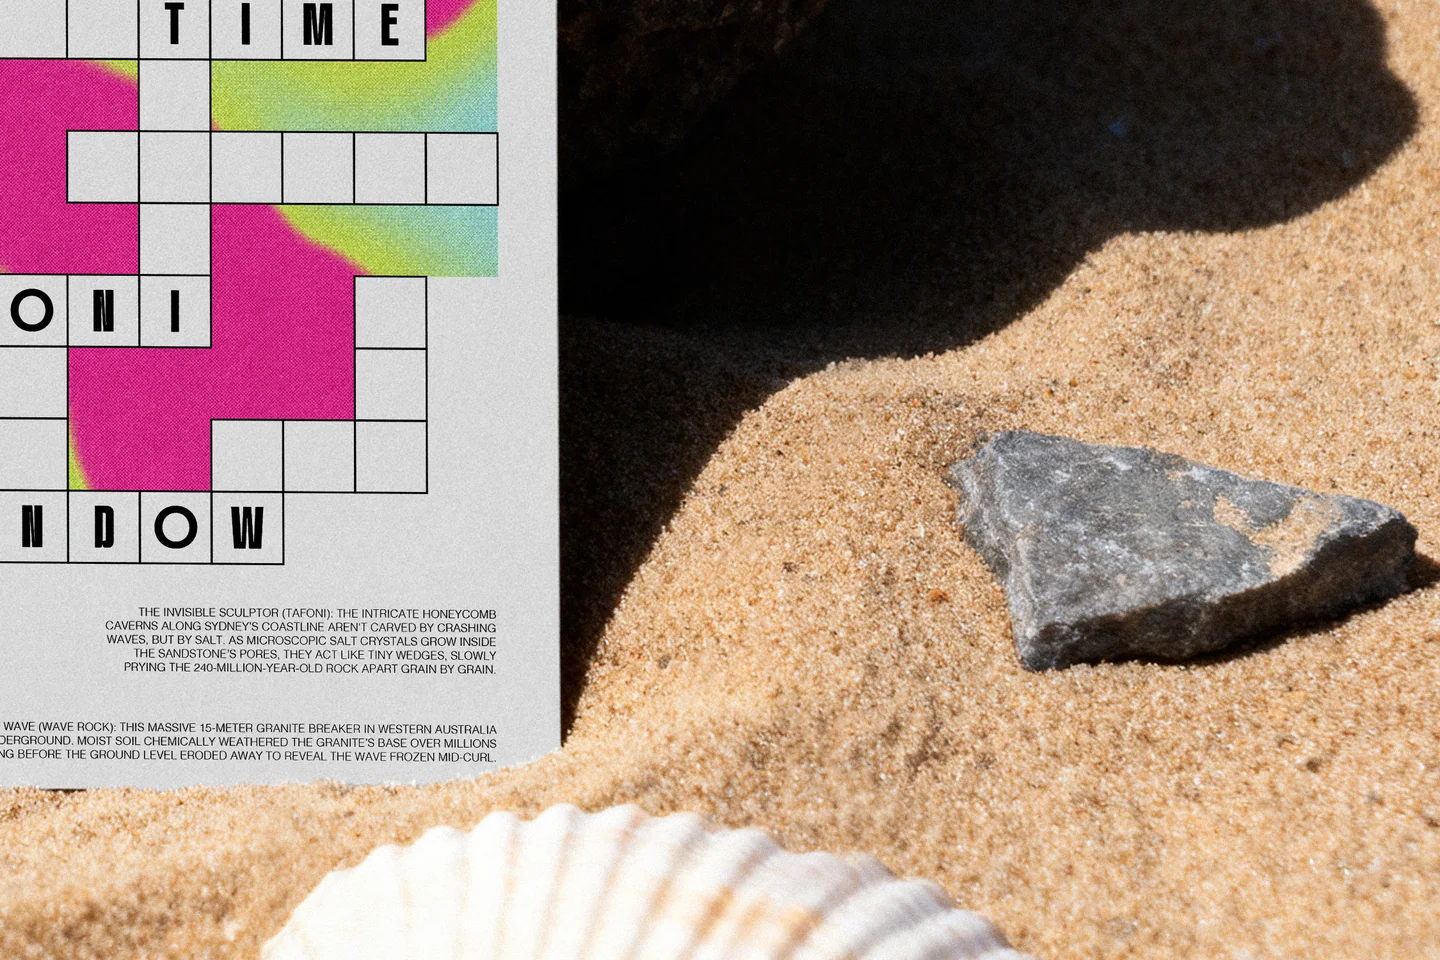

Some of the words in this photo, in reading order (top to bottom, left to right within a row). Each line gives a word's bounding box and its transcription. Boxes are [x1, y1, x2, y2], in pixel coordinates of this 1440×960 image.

[165, 3, 398, 45] TIME
[138, 606, 160, 618] THE
[163, 607, 216, 618] INVISIBLE
[219, 607, 279, 618] SCULPTOR
[282, 607, 333, 619] (TAFONI):
[336, 608, 358, 619] THE
[362, 608, 419, 619] INTRICATE
[422, 609, 497, 620] HONEYCOMB
[105, 620, 159, 631] CAVERNS
[161, 620, 201, 631] ALONG
[204, 620, 259, 632] SYDNEY'S
[261, 621, 324, 632] COASTLINE
[327, 621, 367, 633] AREN'T
[370, 621, 417, 633] CARVED
[419, 622, 434, 633] BY
[437, 622, 496, 634] CRASHING
[134, 648, 155, 659] THE
[158, 648, 237, 660] SANDSTONE'S
[239, 648, 280, 660] PORES,
[283, 649, 312, 660] THEY
[315, 649, 337, 660] ACT
[340, 649, 365, 660] LIKE
[368, 649, 393, 660] TINY
[395, 649, 447, 662] WEDGES,
[450, 650, 497, 661] SLOWLY
[124, 661, 166, 672] PRYING
[169, 662, 191, 673] THE
[193, 662, 323, 673] 240-MILLION-YEAR-OLD
[326, 663, 359, 674] ROCK
[361, 663, 398, 674] APART
[401, 663, 437, 674] GRAIN
[440, 664, 455, 675] BY
[457, 664, 496, 675] GRAIN.
[3, 721, 35, 732] WAVE
[38, 721, 74, 733] (WAVE
[77, 721, 116, 733] ROCK):
[119, 721, 145, 732] THIS
[148, 722, 196, 733] MASSIVE
[200, 722, 253, 733] 15-METER
[256, 722, 305, 734] GRANITE
[308, 723, 361, 734] BREAKER
[364, 724, 375, 734] IN
[378, 723, 432, 735] WESTERN
[434, 724, 497, 735] AUSTRALIA
[17, 748, 62, 760] BEFORE
[65, 748, 86, 760] THE
[89, 749, 140, 760] GROUND
[143, 749, 177, 761] LEVEL
[180, 750, 228, 761] ERODED
[230, 750, 263, 761] AWAY
[265, 750, 281, 761] TO
[284, 750, 327, 762] REVEAL
[330, 751, 352, 762] THE
[354, 751, 387, 762] WAVE
[390, 751, 435, 763] FROZEN
[438, 751, 496, 763] MID-CURL.
